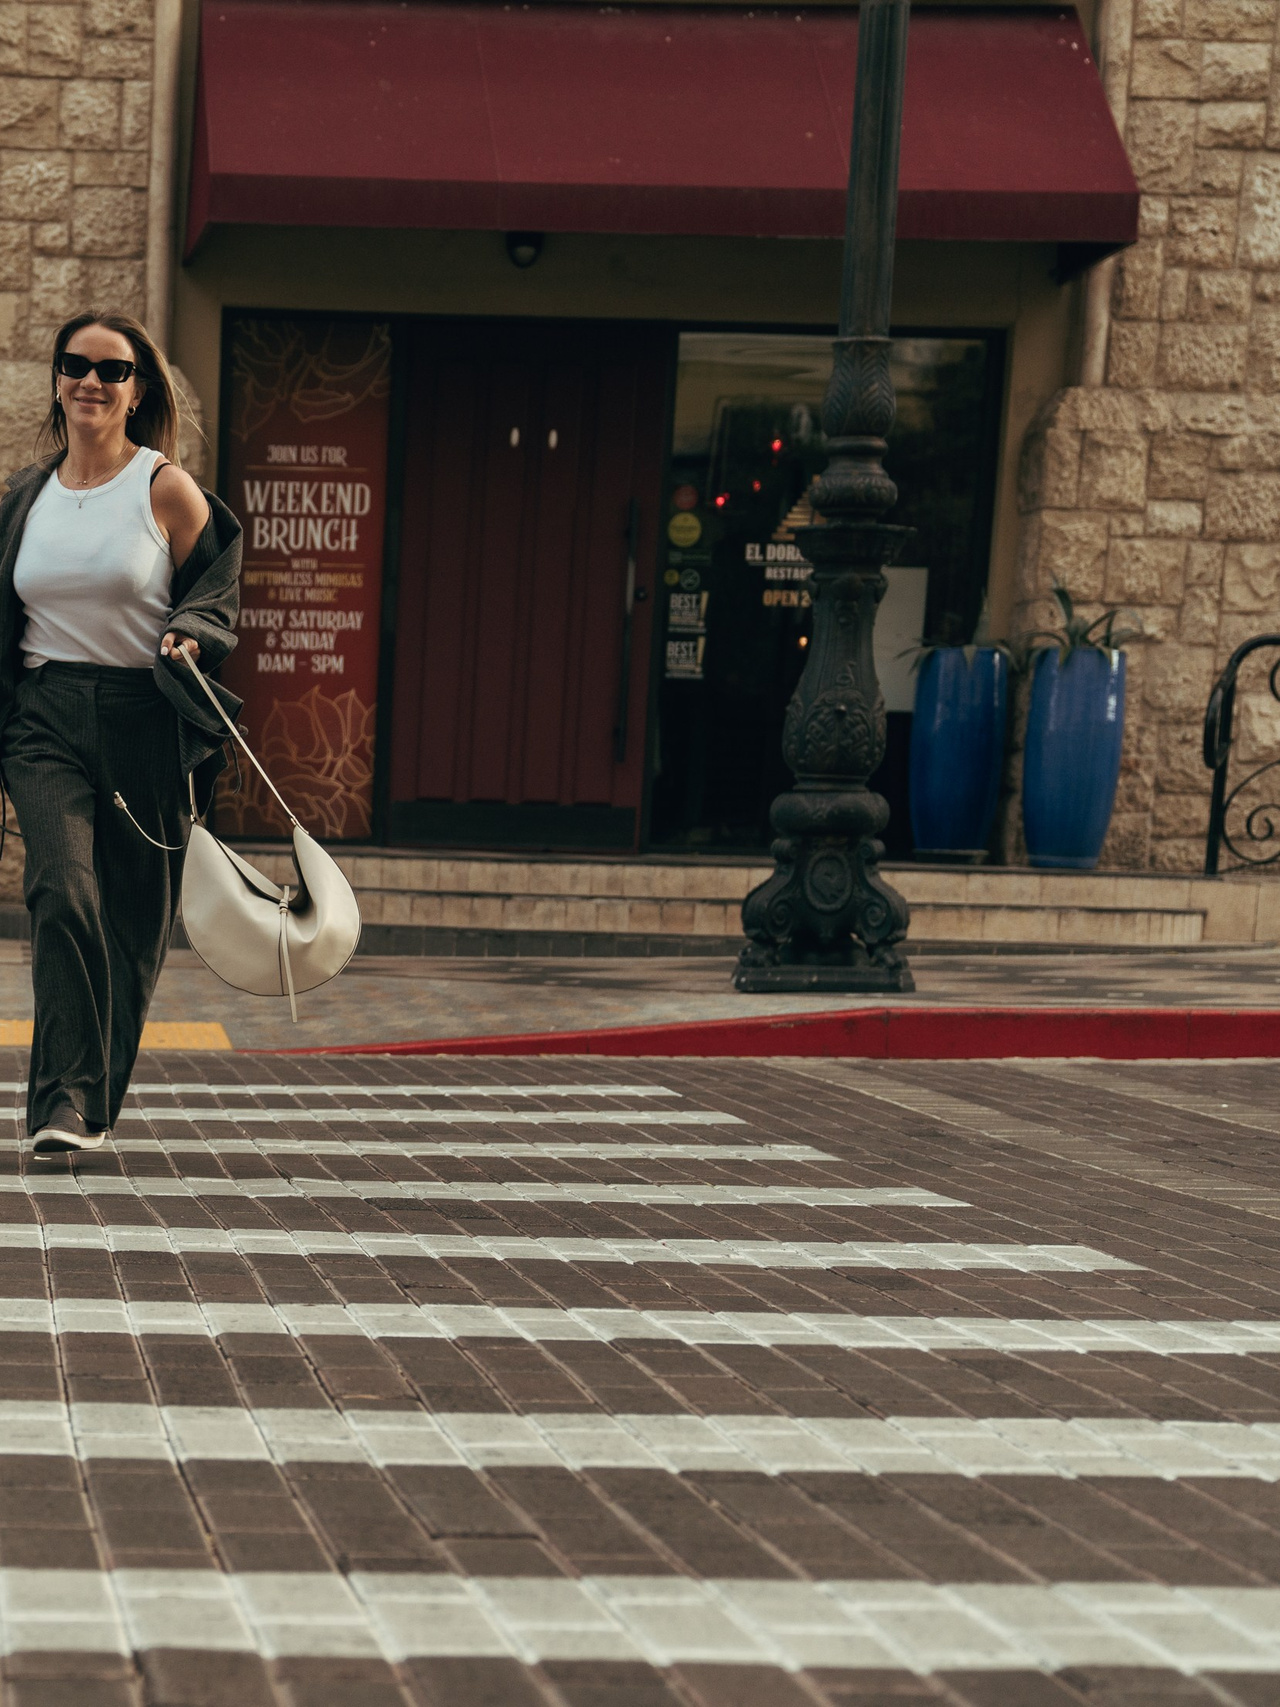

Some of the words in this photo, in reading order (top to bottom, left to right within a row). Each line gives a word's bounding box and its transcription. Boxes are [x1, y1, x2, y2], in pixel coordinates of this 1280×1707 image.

[267, 444, 298, 463] JOIN
[300, 444, 320, 464] US
[321, 445, 349, 467] FOR
[243, 480, 371, 516] WEEKEND
[252, 516, 359, 555] BRUNCH
[746, 544, 763, 561] EL
[766, 544, 804, 561] DORA
[765, 568, 814, 580] RESTAU
[278, 587, 303, 602] LIVE
[763, 590, 798, 606] OPEN
[801, 591, 812, 607] 2
[241, 609, 285, 630] EVERY
[289, 610, 364, 631] SATURDAY
[265, 631, 277, 649] &
[281, 631, 337, 650] SUNDAY
[257, 653, 296, 673] 10AM
[311, 654, 345, 675] 3PM
